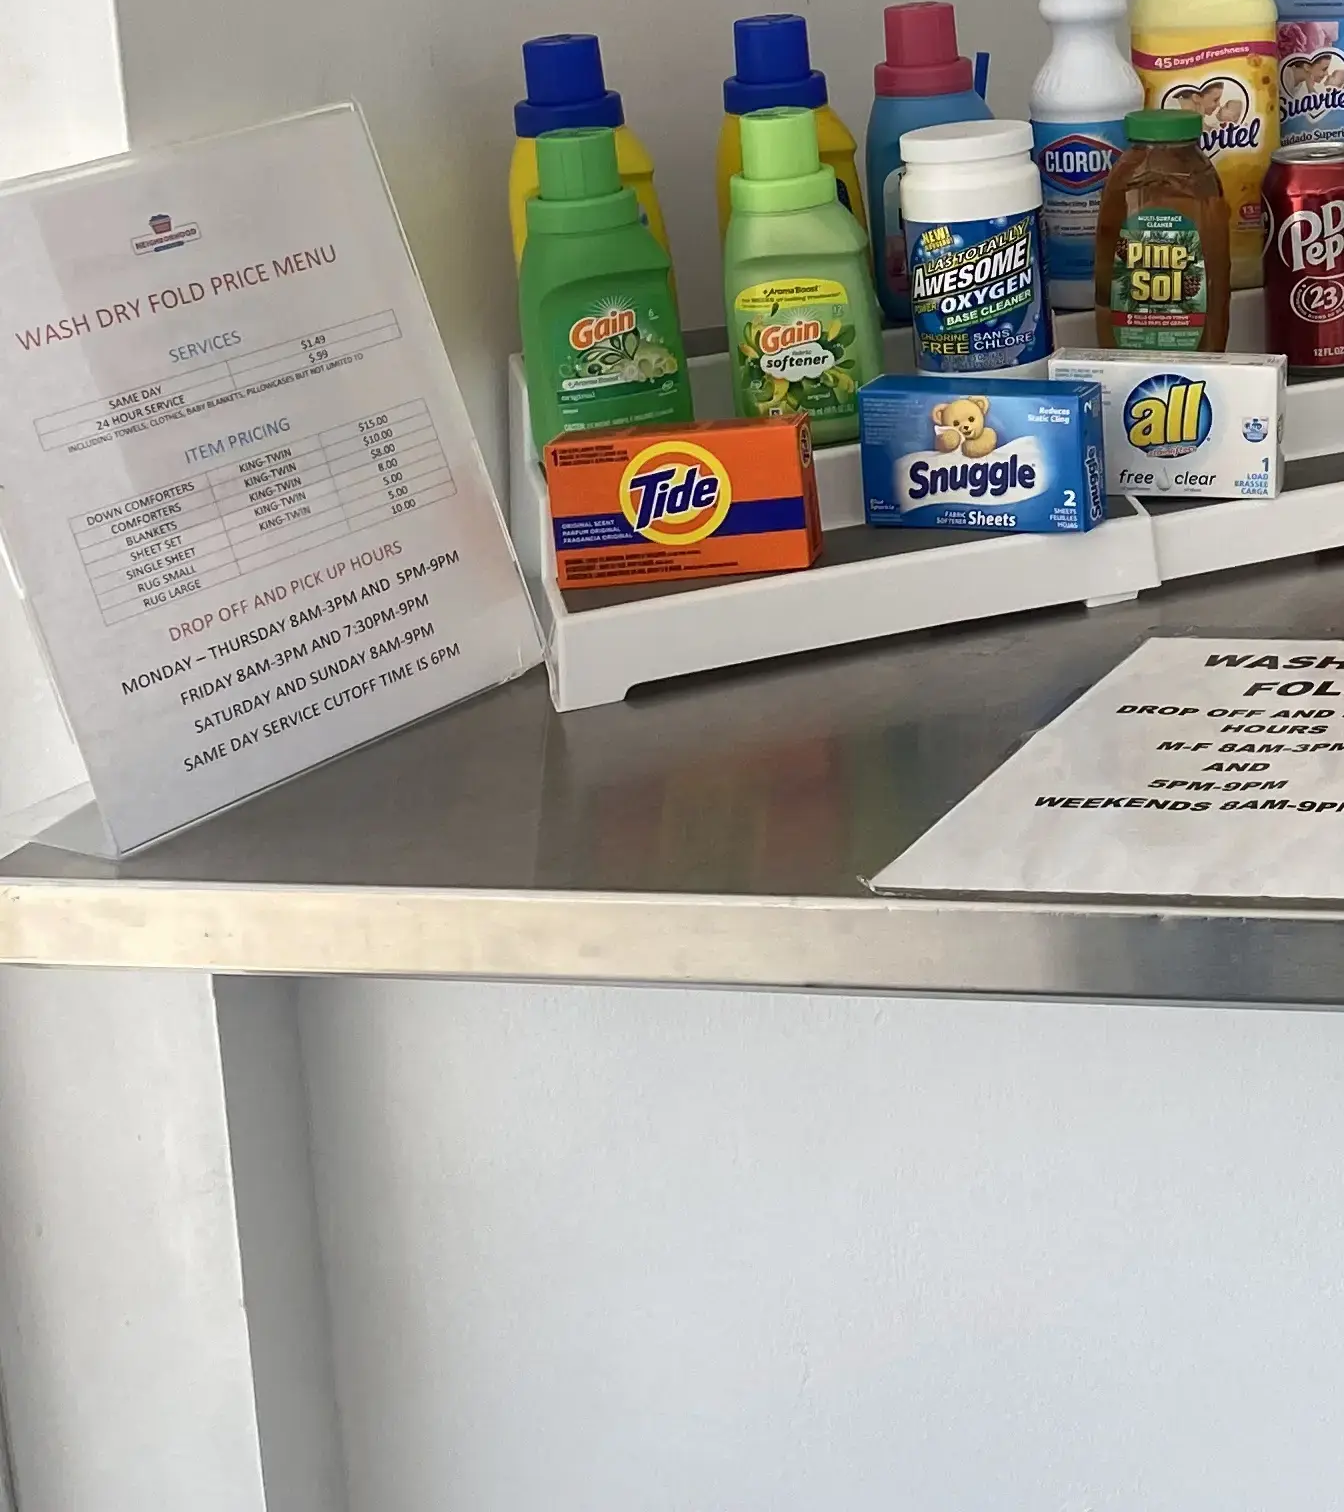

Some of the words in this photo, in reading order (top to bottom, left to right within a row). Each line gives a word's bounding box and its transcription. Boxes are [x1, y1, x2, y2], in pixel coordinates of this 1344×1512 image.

[1154, 57, 1172, 69] 45
[1173, 56, 1194, 66] Days
[1196, 49, 1205, 61] of
[1205, 45, 1249, 59] Freshness
[1045, 150, 1112, 173] CLOROX
[958, 224, 1025, 261] TOTALLY
[913, 237, 1027, 299] AWESOME
[1127, 242, 1195, 270] Pine-
[15, 314, 91, 351] WASH
[96, 299, 141, 329] DRY
[148, 282, 205, 314] FOLD
[210, 263, 270, 295] PRICE
[272, 245, 337, 278] MENU
[941, 268, 1032, 313] OXYGEN
[1131, 269, 1182, 302] Sol
[1310, 286, 1338, 310] 23
[946, 309, 978, 326] BASE
[980, 289, 1031, 316] CLEANER
[569, 308, 635, 350] Gain
[760, 320, 820, 355] Gain
[973, 330, 1010, 341] SANS
[973, 333, 1033, 351] CHLORE
[169, 330, 242, 364] SERVICES
[921, 343, 969, 354] FREE
[766, 355, 828, 371] softener
[1128, 381, 1206, 447] all
[184, 439, 226, 464] ITEM
[228, 418, 291, 448] PRICING
[86, 506, 122, 526] DOWN
[125, 482, 195, 512] COMFORTERS
[239, 448, 292, 473] KING-TWIN
[358, 415, 388, 432] $15.00
[909, 454, 1036, 499] Snuggle
[1119, 469, 1153, 484] free
[1174, 471, 1216, 486] clear
[1262, 458, 1269, 471] 1
[629, 466, 720, 531] Tide
[1063, 490, 1076, 506] 2
[968, 511, 1016, 527] Sheets
[121, 656, 192, 695] MONDAY
[208, 619, 286, 660] THURSDAY
[289, 591, 358, 627] 8AM-3PM
[361, 578, 390, 599] AND
[396, 550, 460, 585] 5PM-9PM
[262, 702, 321, 738] SERVICE
[323, 679, 376, 711] CUTOFF
[379, 662, 414, 687] TIME
[430, 642, 461, 666] 6PM
[1116, 705, 1199, 715] DROP
[1207, 709, 1266, 718] OFF
[1270, 709, 1335, 719] AND
[1220, 725, 1327, 734] HOURS
[1156, 742, 1213, 752] M-F
[1202, 763, 1270, 772] AND
[1148, 779, 1289, 791] 5PM-9PM
[1034, 796, 1210, 812] WEEKENDS
